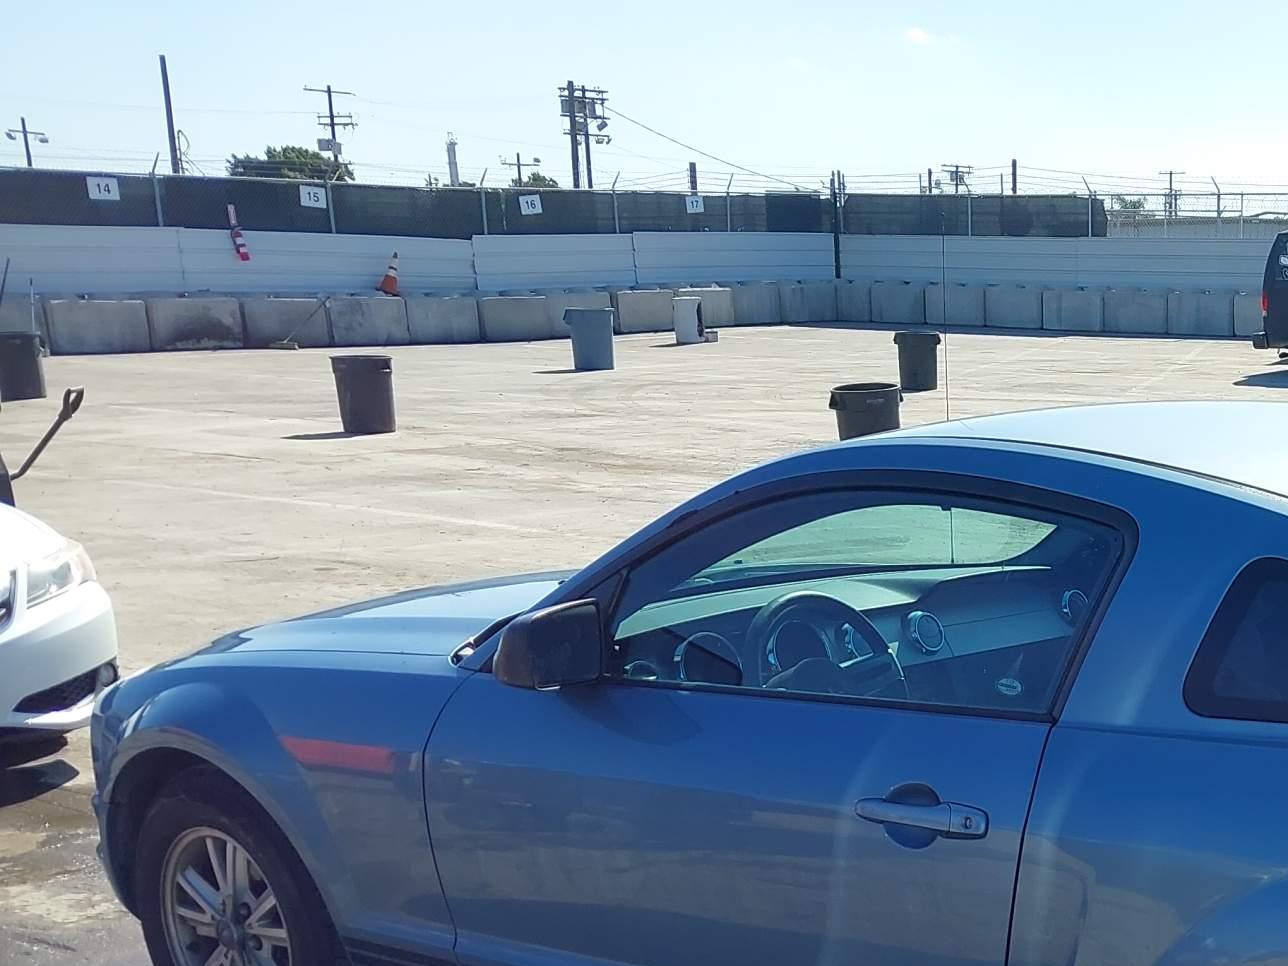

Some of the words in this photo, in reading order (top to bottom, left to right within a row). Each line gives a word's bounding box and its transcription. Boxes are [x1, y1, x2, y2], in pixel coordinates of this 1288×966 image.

[96, 183, 111, 194] 14
[306, 191, 320, 203] 15
[525, 199, 537, 210] 16
[690, 199, 699, 209] 17
